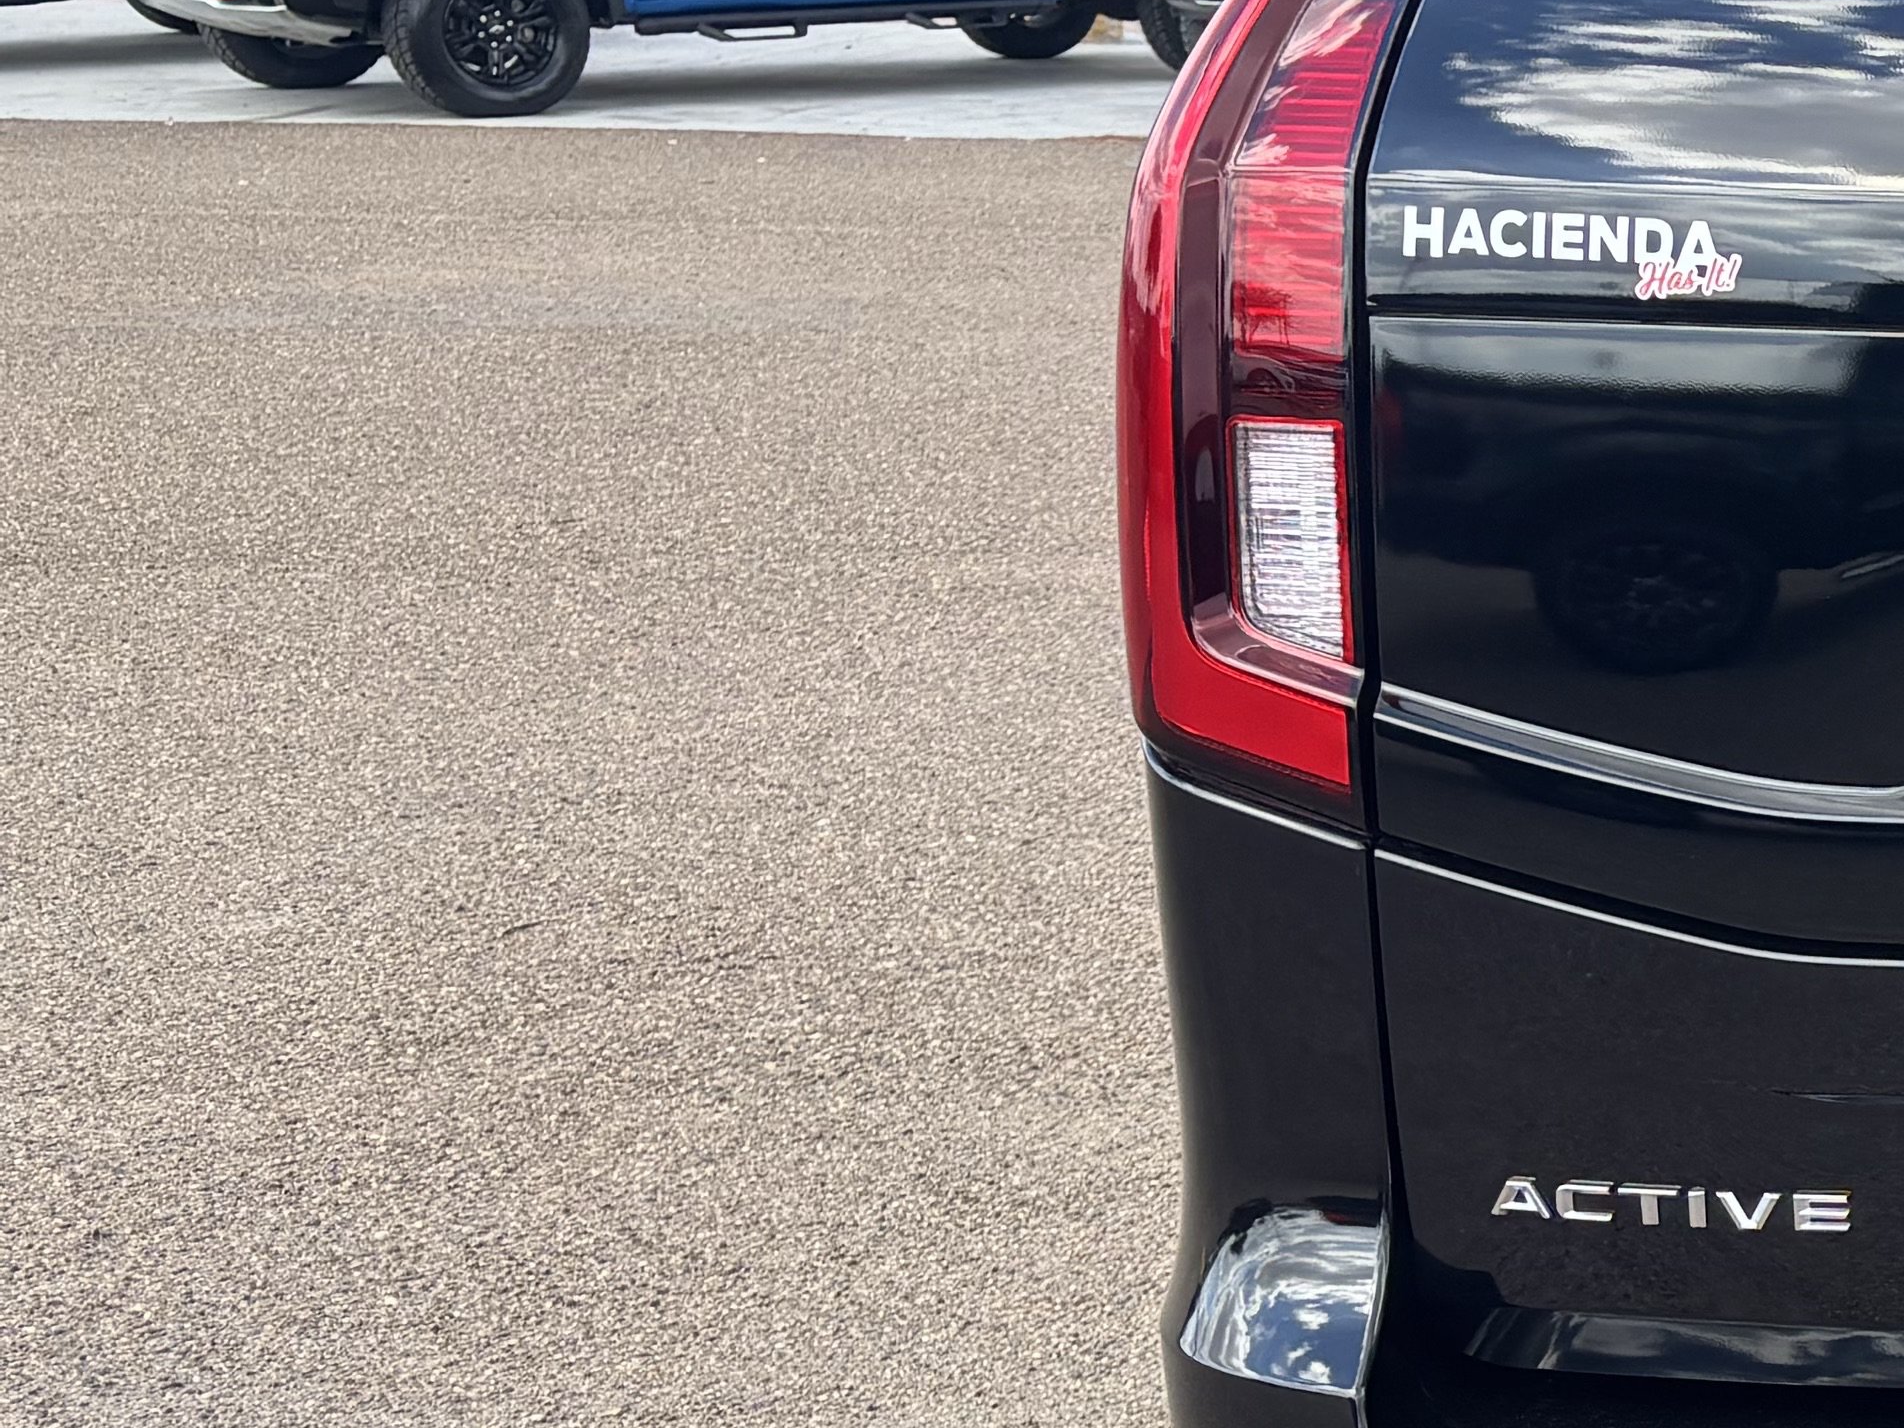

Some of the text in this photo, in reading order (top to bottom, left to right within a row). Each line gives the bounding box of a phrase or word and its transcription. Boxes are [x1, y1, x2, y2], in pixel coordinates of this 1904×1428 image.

[1402, 205, 1717, 269] HACIENDA
[1640, 257, 1738, 296] Has It!
[1491, 1175, 1852, 1231] ACTIVE
